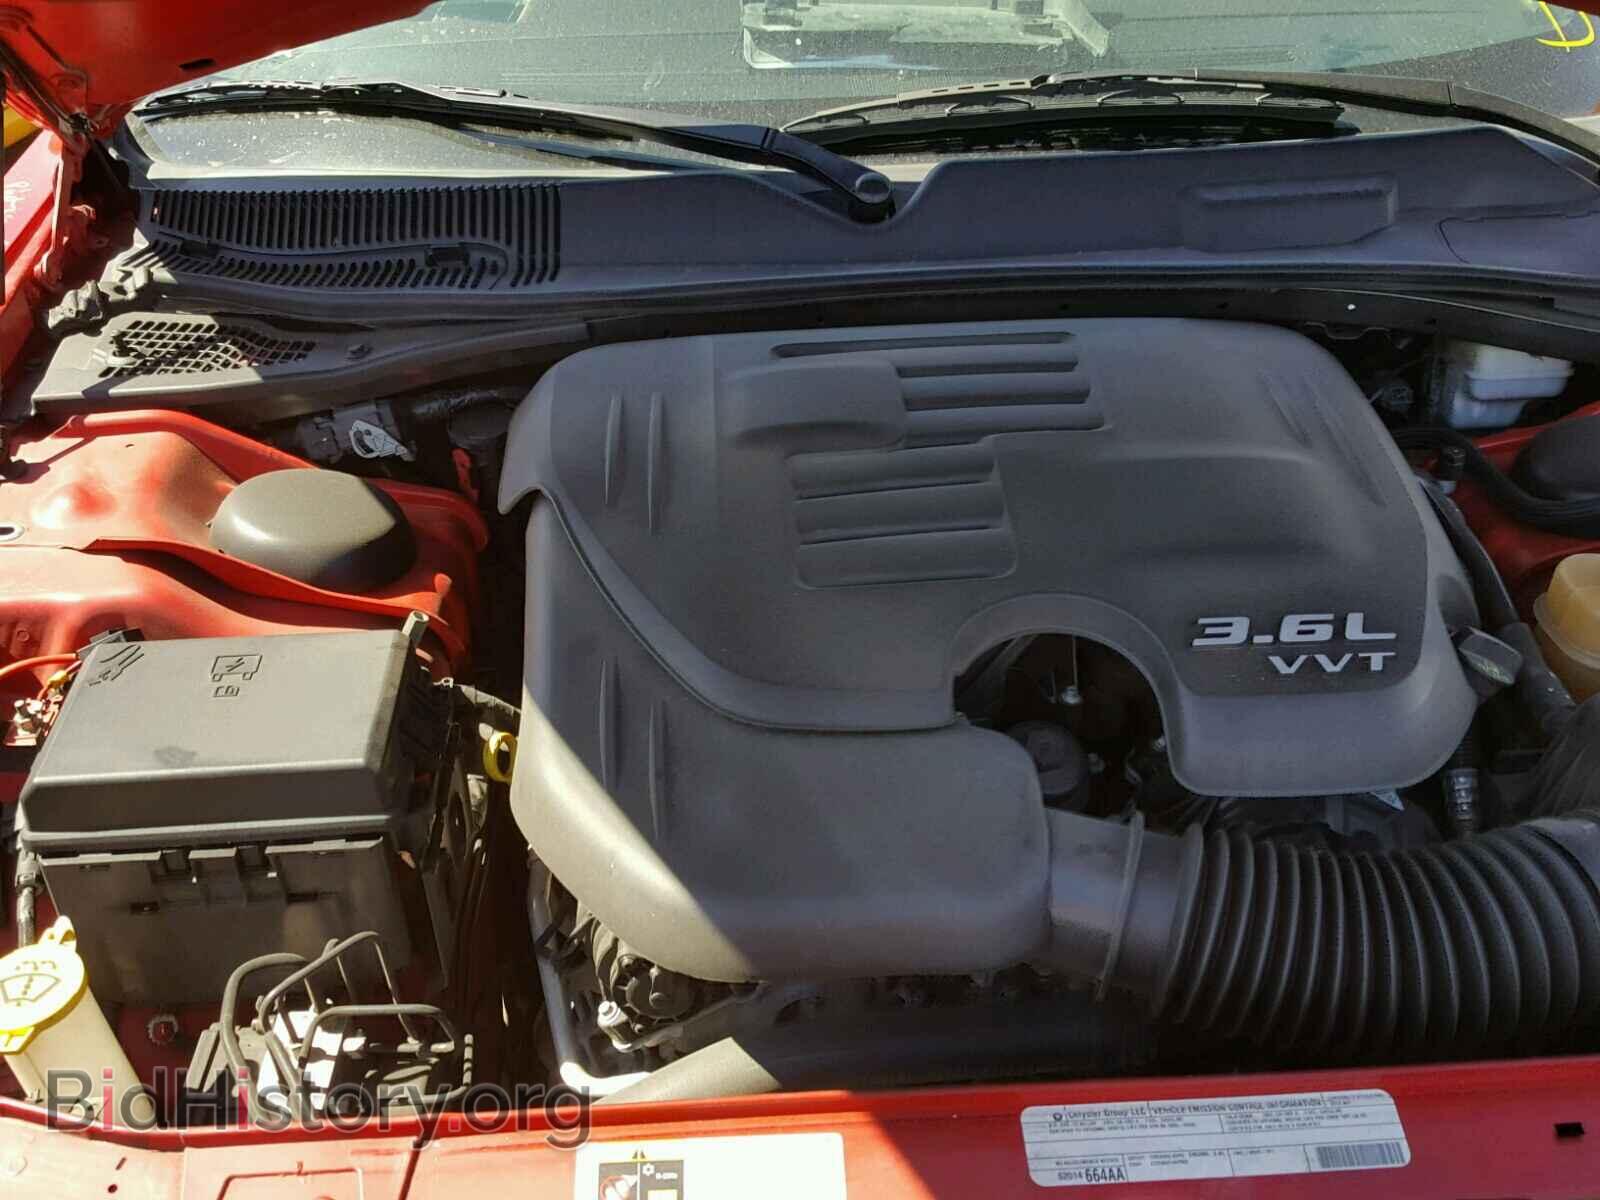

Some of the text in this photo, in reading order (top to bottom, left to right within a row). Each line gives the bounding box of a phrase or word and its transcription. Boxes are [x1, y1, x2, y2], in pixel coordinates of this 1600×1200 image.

[1192, 612, 1397, 647] 3.6L
[1268, 652, 1397, 674] VVT
[1151, 1106, 1185, 1115] VEHICLE
[1187, 1103, 1226, 1113] EMISSION
[1228, 1101, 1265, 1112] CONTROL
[1267, 1098, 1322, 1109] INFORMATION
